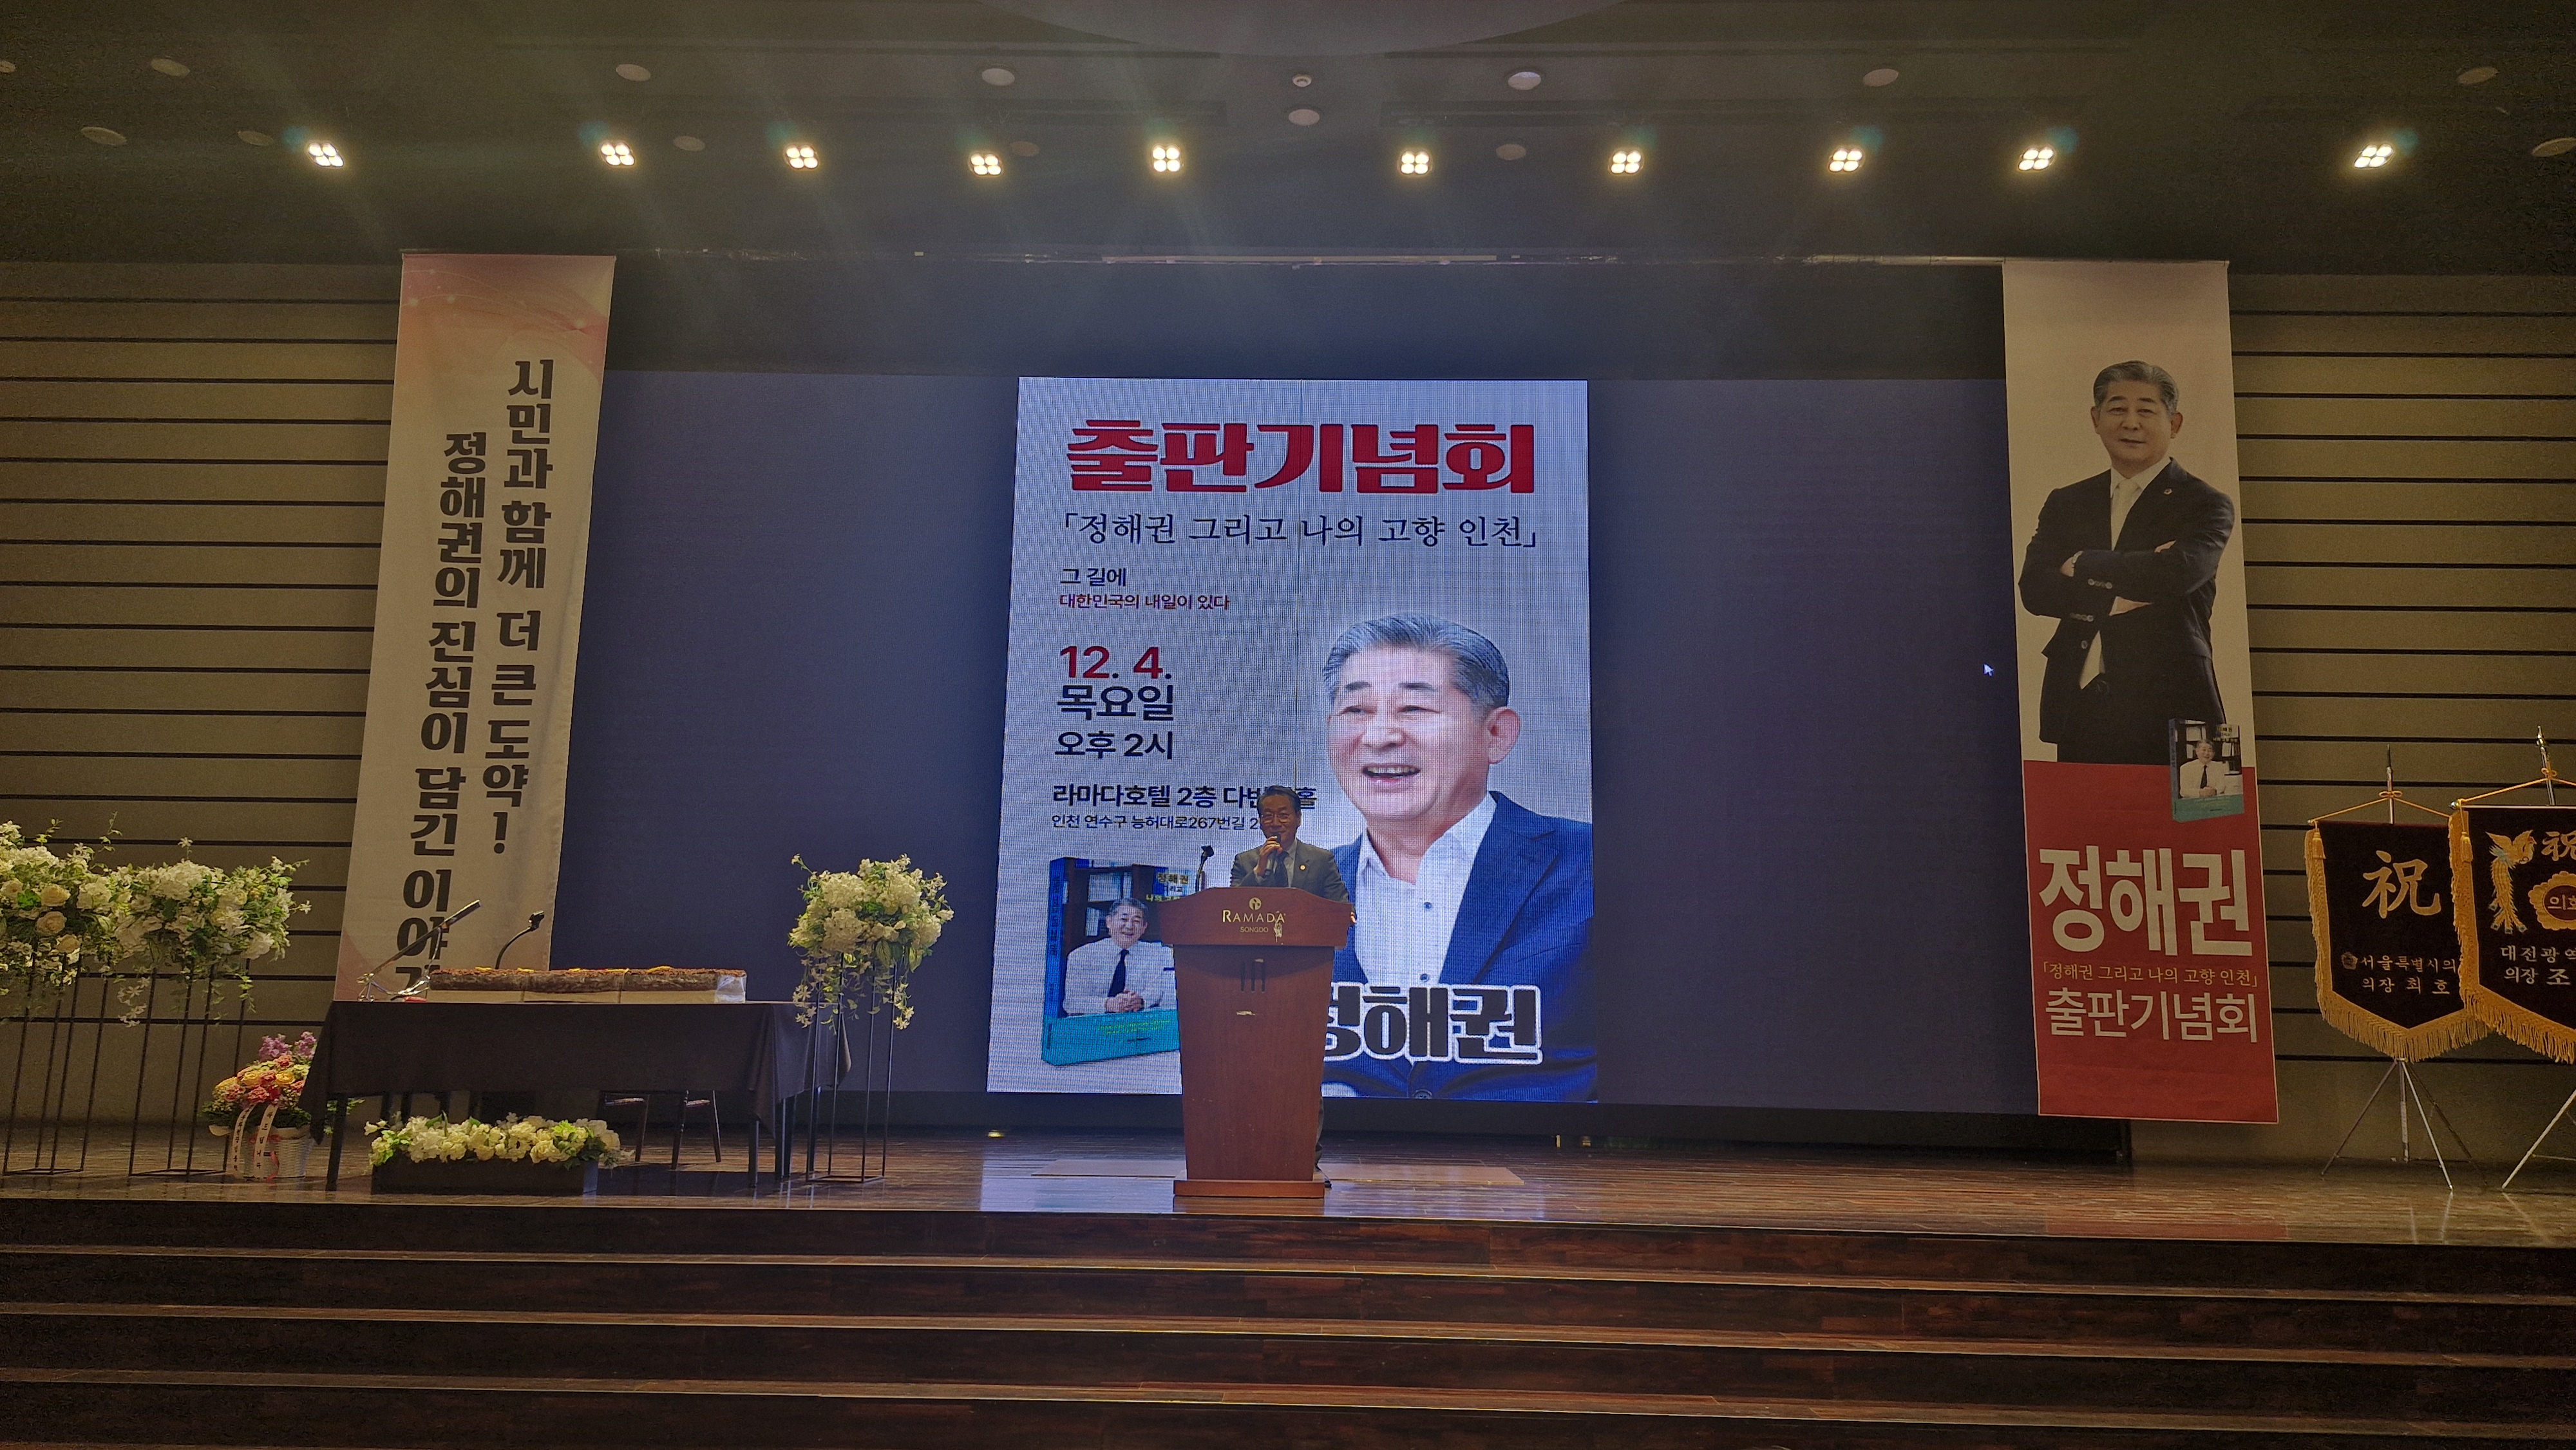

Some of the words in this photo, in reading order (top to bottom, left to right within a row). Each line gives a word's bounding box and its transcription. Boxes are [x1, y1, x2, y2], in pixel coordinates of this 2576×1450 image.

[504, 359, 553, 489] 시민과
[1066, 420, 1535, 494] 출판기념회
[433, 432, 486, 608] 정해권의
[1189, 514, 1288, 545] 그리고
[1302, 514, 1363, 546] 나의
[1378, 516, 1444, 547] 고향
[497, 500, 551, 588] 함께
[1060, 569, 1081, 584] 그
[1086, 567, 1126, 587] 길에
[1059, 594, 1140, 609] 대한민국의
[1145, 594, 1193, 610] 내일이
[1197, 594, 1231, 610] 있다
[497, 610, 541, 651] 더
[1060, 646, 1119, 679] 12.
[1133, 646, 1172, 679] 4.
[421, 621, 476, 753] 진심이
[491, 664, 536, 706] 큰
[1057, 684, 1174, 721] 목요일
[1054, 730, 1116, 759] 오후
[1124, 731, 1173, 760] 2시
[482, 720, 531, 854] 도약!
[1053, 784, 1170, 807] 라마다호텔
[1177, 784, 1217, 808] 2층
[410, 767, 466, 856] 담긴
[1051, 814, 1080, 829] 인천
[1084, 814, 1127, 829] 연수구
[1132, 814, 1245, 830] 능허대로267번길
[2541, 830, 2576, 862] 祝
[1157, 872, 1189, 885] 정해권
[2362, 850, 2441, 919] 祝
[1222, 910, 1285, 923] RAMADA
[2038, 845, 2253, 956] 정해권
[2098, 965, 2144, 982] 그리고
[2148, 966, 2178, 983] 나의
[2183, 968, 2215, 985] 고향
[2362, 977, 2395, 993] 의장
[2504, 966, 2539, 984] 의장
[2546, 968, 2571, 985] 조
[2045, 987, 2257, 1043] 출판기념회
